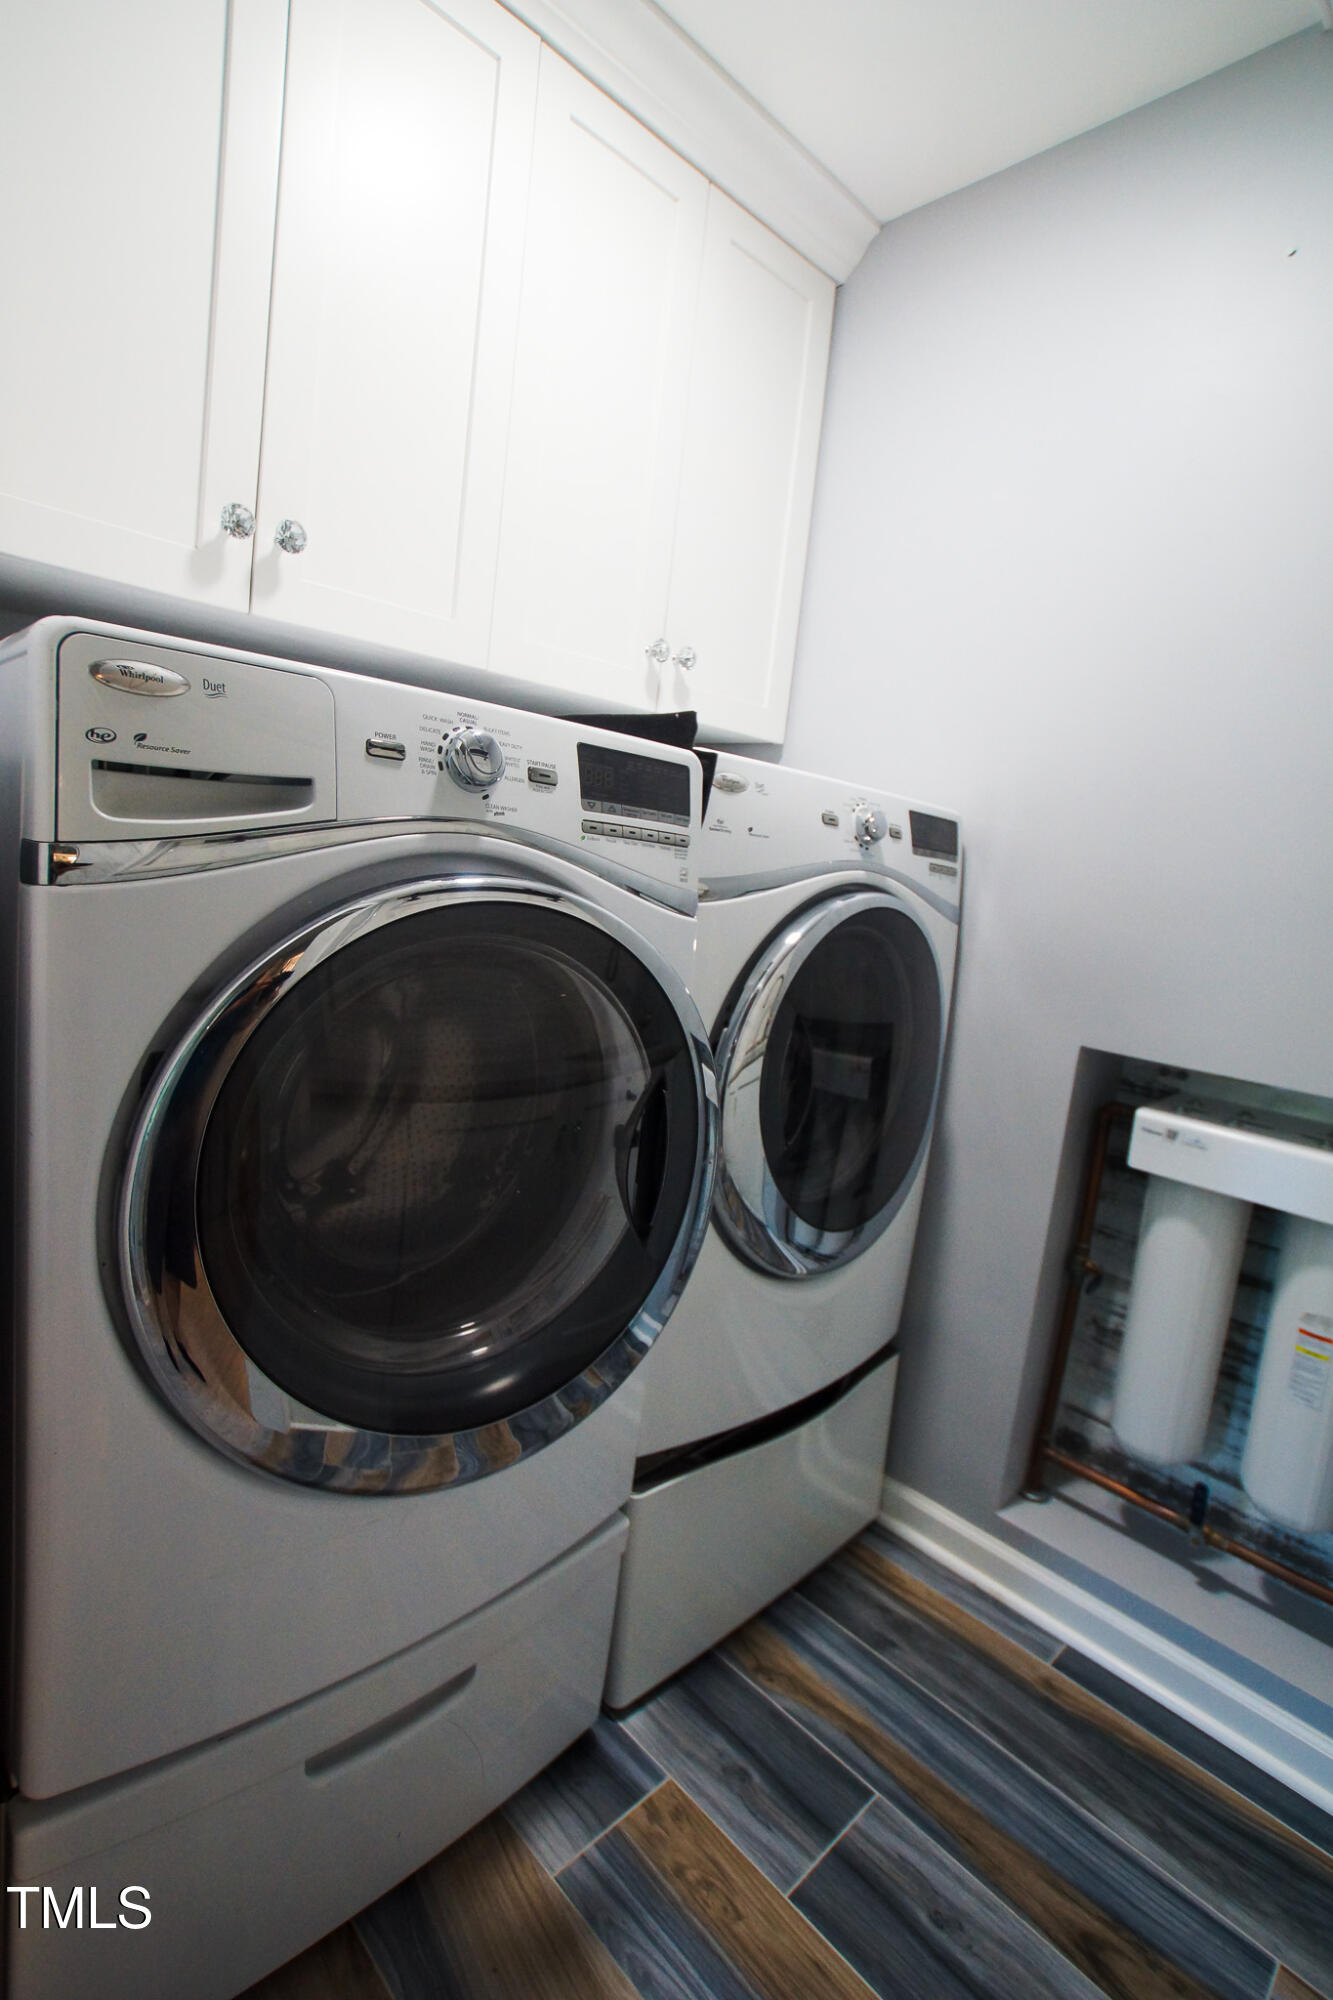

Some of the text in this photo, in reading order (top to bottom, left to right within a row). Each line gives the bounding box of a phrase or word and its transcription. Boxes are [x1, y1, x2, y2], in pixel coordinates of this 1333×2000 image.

[119, 669, 164, 684] Whirlpool
[202, 678, 226, 693] Duet
[422, 713, 438, 721] QUICK
[90, 728, 112, 743] he
[374, 731, 397, 740] POWER
[136, 741, 191, 755] Resource Saver
[526, 759, 556, 769] START/PAUSE
